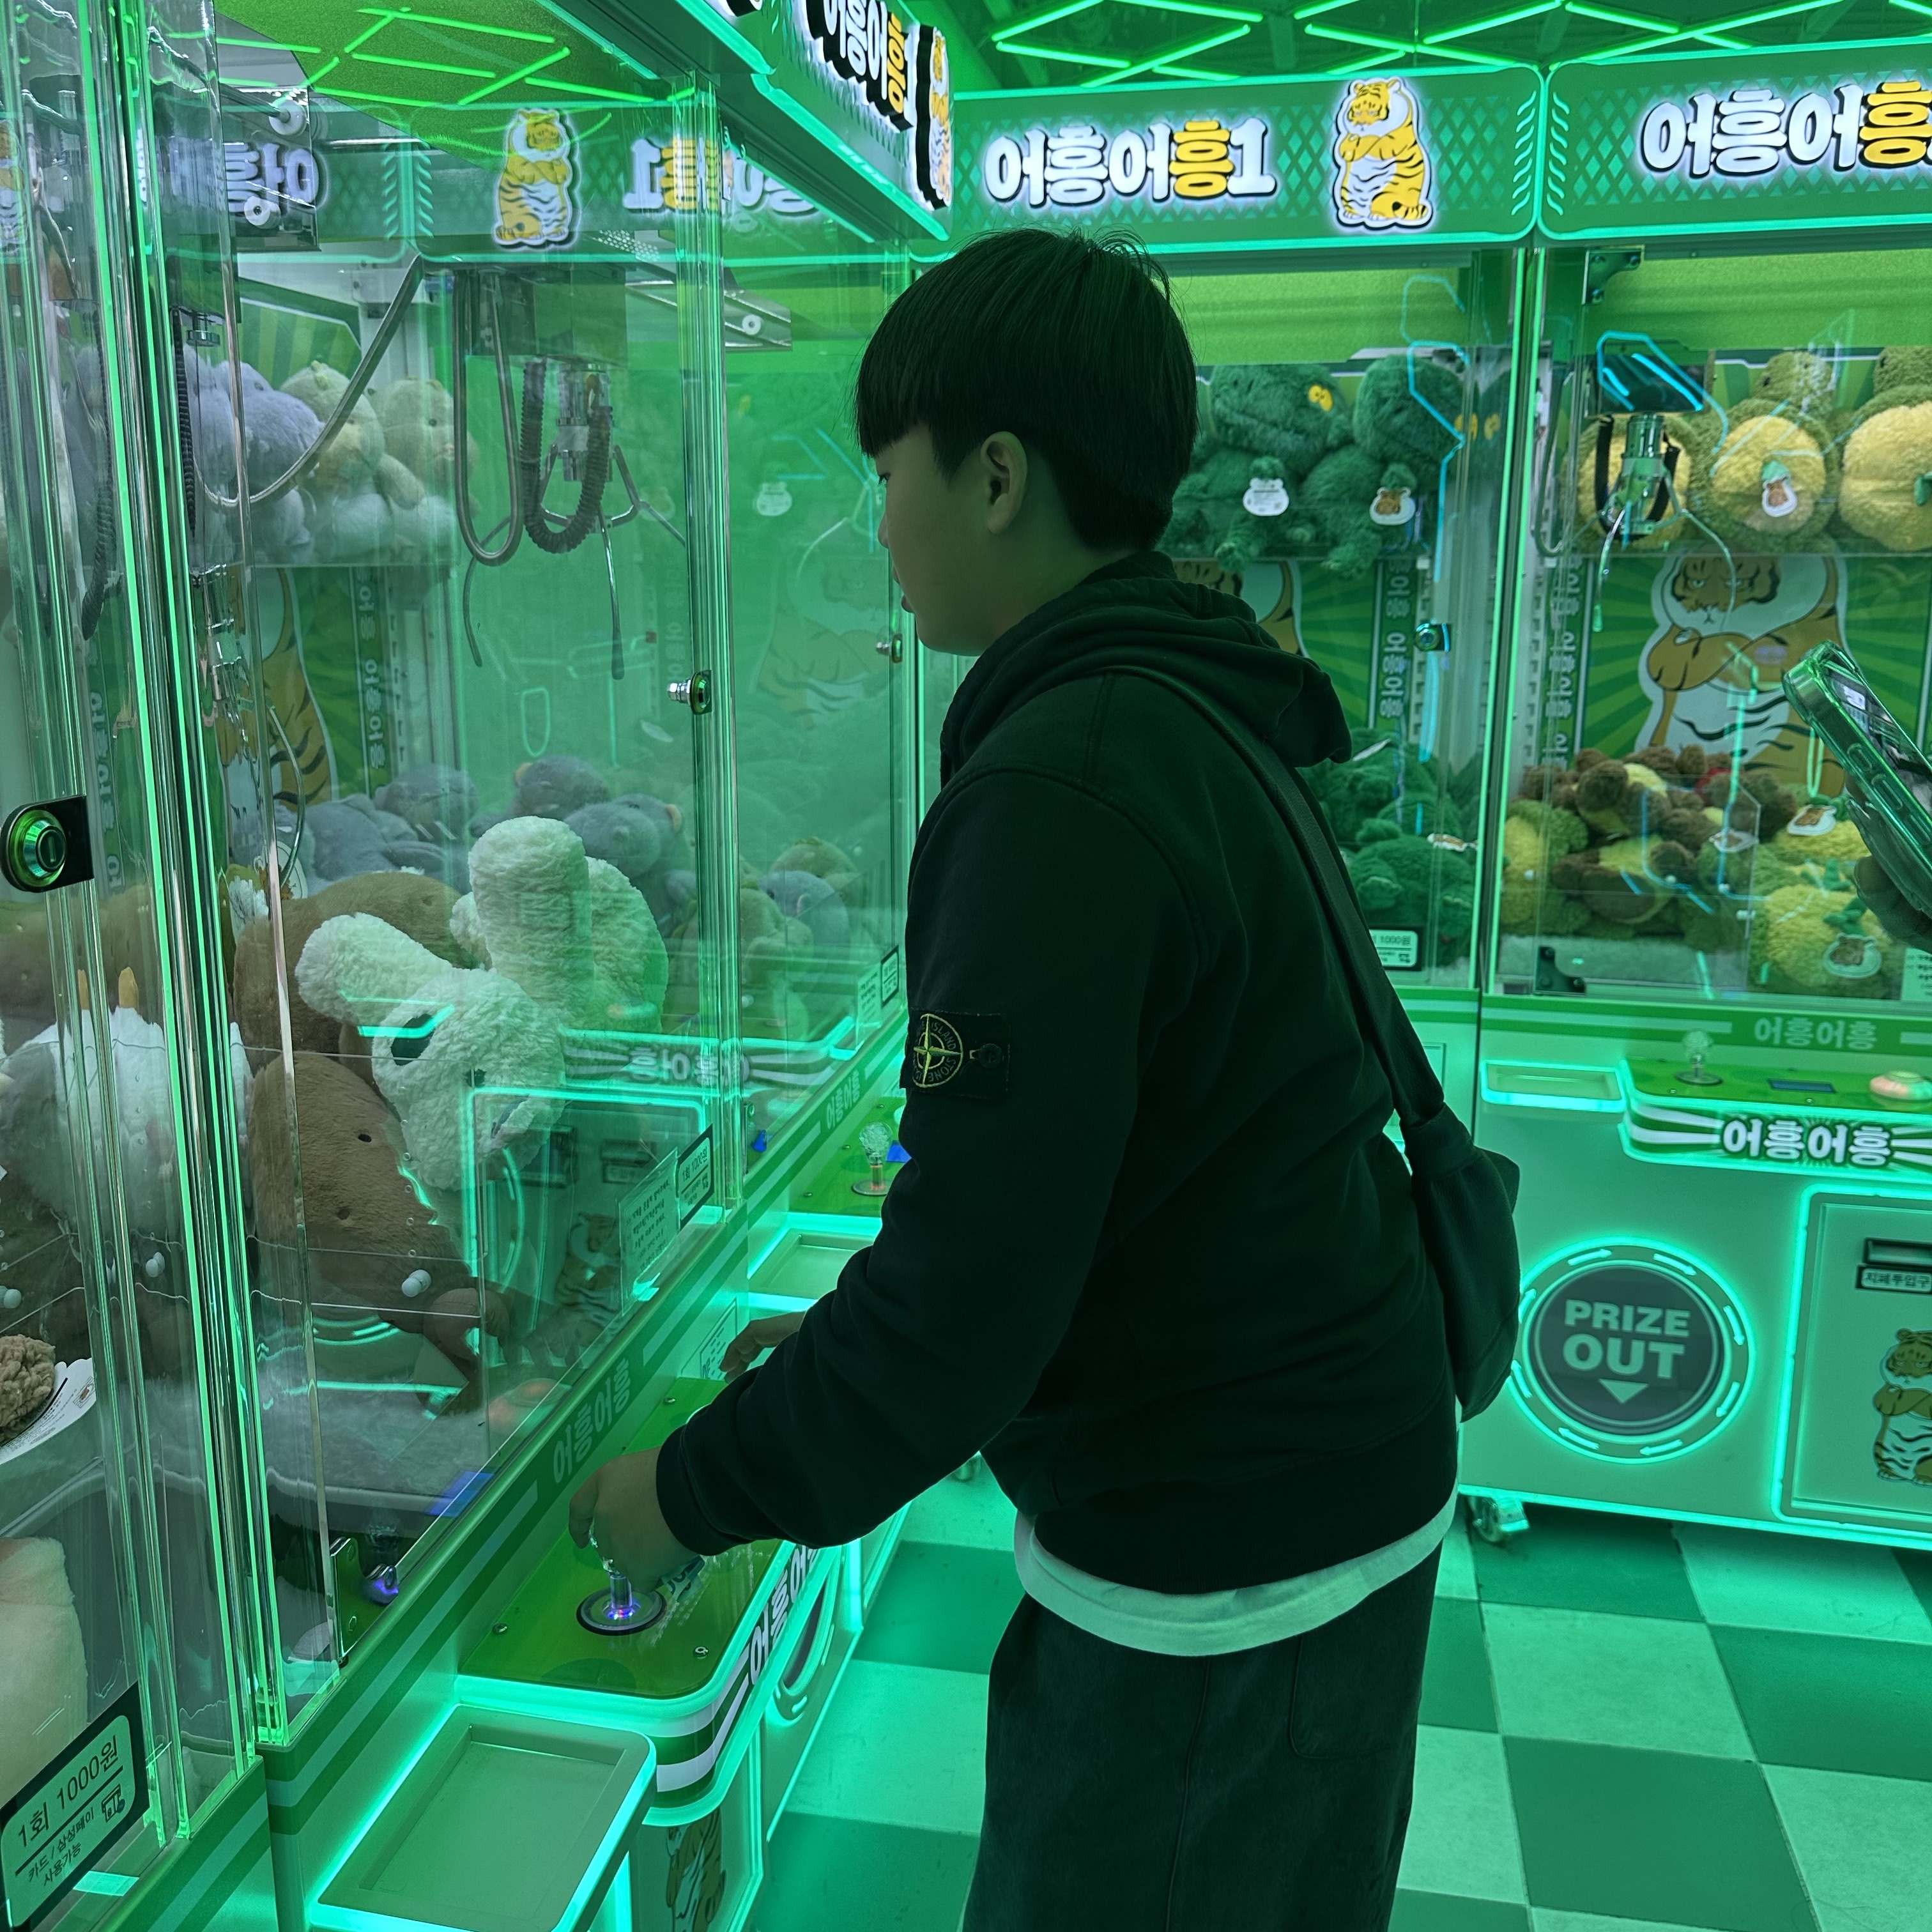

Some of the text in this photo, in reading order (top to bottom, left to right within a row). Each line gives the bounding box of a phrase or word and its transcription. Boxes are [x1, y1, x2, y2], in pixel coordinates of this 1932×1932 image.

[1641, 80, 1932, 179] 어흥어흥
[983, 118, 1277, 208] 어흥어흥1
[1379, 632, 1407, 718] 어흥어흥
[931, 1022, 957, 1051] ISLAND
[1754, 1016, 1876, 1050] 어흥어흥
[926, 1056, 956, 1083] STONE
[827, 1069, 861, 1130] 어흥어흥
[1722, 1118, 1891, 1167] 어흥어흥
[1565, 1299, 1690, 1338] PRIZE
[1563, 1333, 1685, 1379] OUT
[553, 1358, 631, 1483] 어흥어흥
[18, 1734, 119, 1847] 1회 1000원
[28, 1853, 50, 1882] 카드
[57, 1806, 95, 1850] 삼성페이
[43, 1842, 82, 1886] 사용가능
